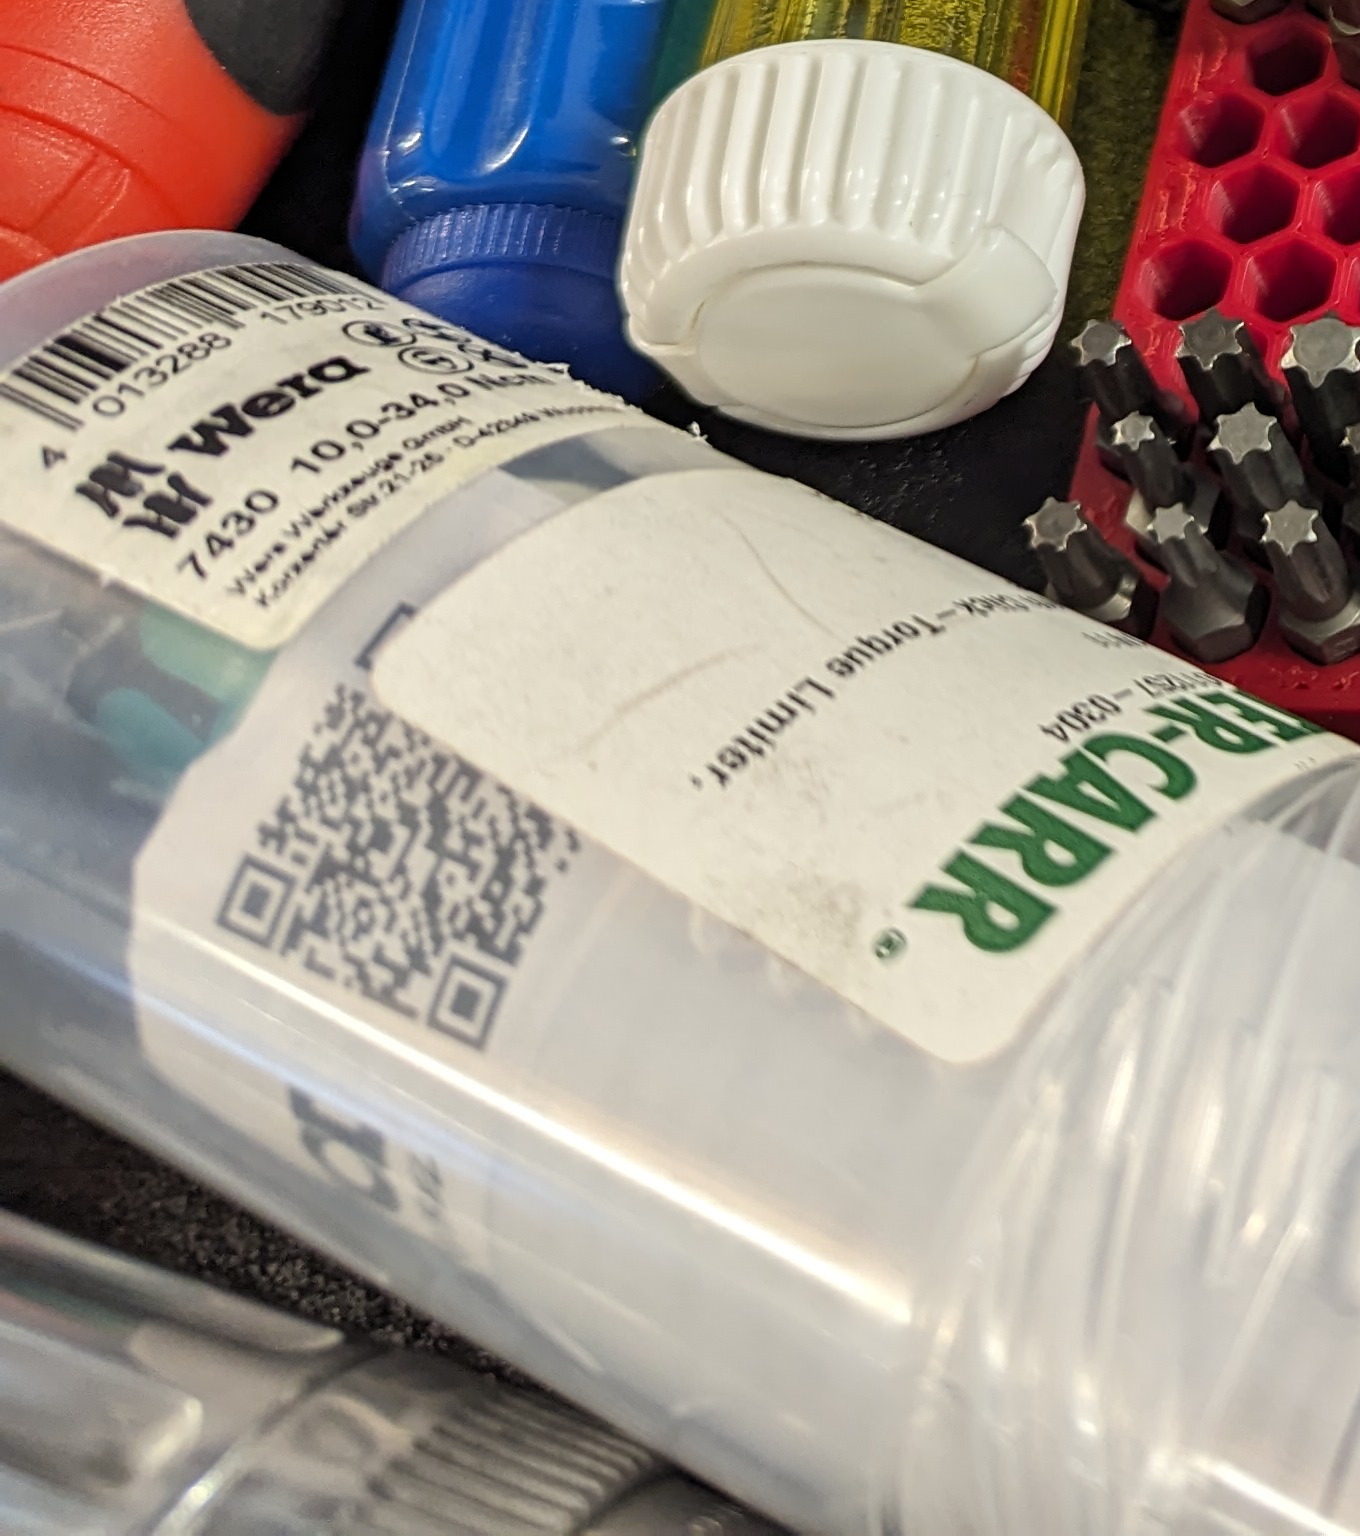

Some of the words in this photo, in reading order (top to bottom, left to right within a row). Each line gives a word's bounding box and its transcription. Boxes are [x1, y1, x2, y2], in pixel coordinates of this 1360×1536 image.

[41, 445, 68, 470] 4
[92, 331, 232, 417] 013288
[260, 296, 385, 325] 179012
[402, 415, 473, 451] GmbH
[178, 490, 280, 579] 7430
[291, 382, 471, 475] 10,0-34,0
[464, 373, 557, 392] Ncm
